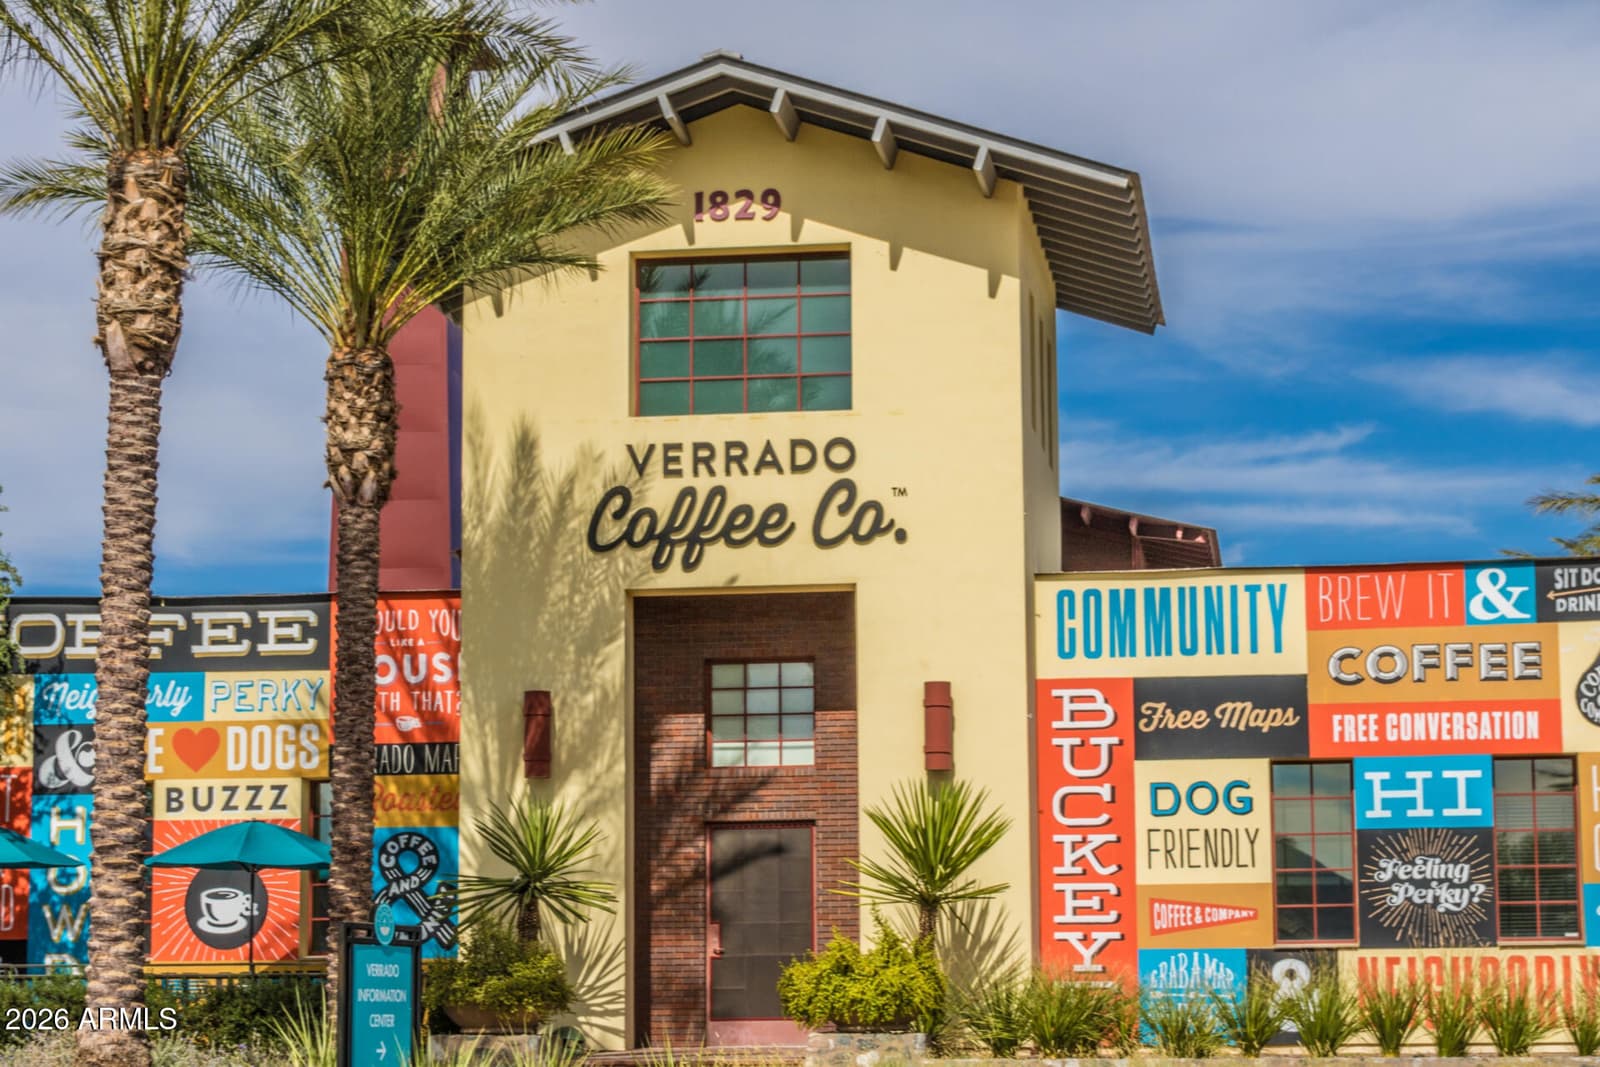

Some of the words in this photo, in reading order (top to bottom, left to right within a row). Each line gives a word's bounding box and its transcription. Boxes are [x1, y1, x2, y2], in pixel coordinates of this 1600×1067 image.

[693, 188, 783, 223] 1829
[626, 436, 857, 479] VERRADO
[587, 485, 796, 573] Coffee
[812, 478, 908, 550] Co.
[1469, 567, 1531, 621] &
[1553, 567, 1579, 590] SIT
[1318, 573, 1406, 623] BREW
[1427, 572, 1454, 620] IT
[1555, 593, 1600, 613] DRIN
[1056, 583, 1288, 660] COMMUNITY
[1327, 641, 1543, 686] COFFEE
[210, 677, 324, 713] PERKY
[1138, 702, 1212, 732] Free
[1214, 701, 1301, 732] Maps
[1332, 714, 1380, 743] FREE
[1385, 711, 1540, 742] CONVERSATION
[226, 723, 320, 772] DOGS
[165, 784, 290, 814] BUZZZ
[1149, 779, 1254, 818] DOG
[1363, 769, 1484, 820] HI
[380, 834, 437, 869] COFFEE
[1146, 827, 1260, 870] FRIENDLY
[388, 876, 420, 897] AND
[1374, 856, 1471, 885] Feeling
[1386, 881, 1487, 913] Perky?
[1153, 902, 1193, 930] COFFEE
[1194, 906, 1203, 924] &
[1204, 907, 1257, 923] COMPANY
[366, 963, 401, 978] VERRADO
[1151, 953, 1188, 990] GRAB
[1191, 951, 1201, 988] A
[357, 988, 408, 1003] INFORMATION
[369, 1013, 396, 1028] CENTER
